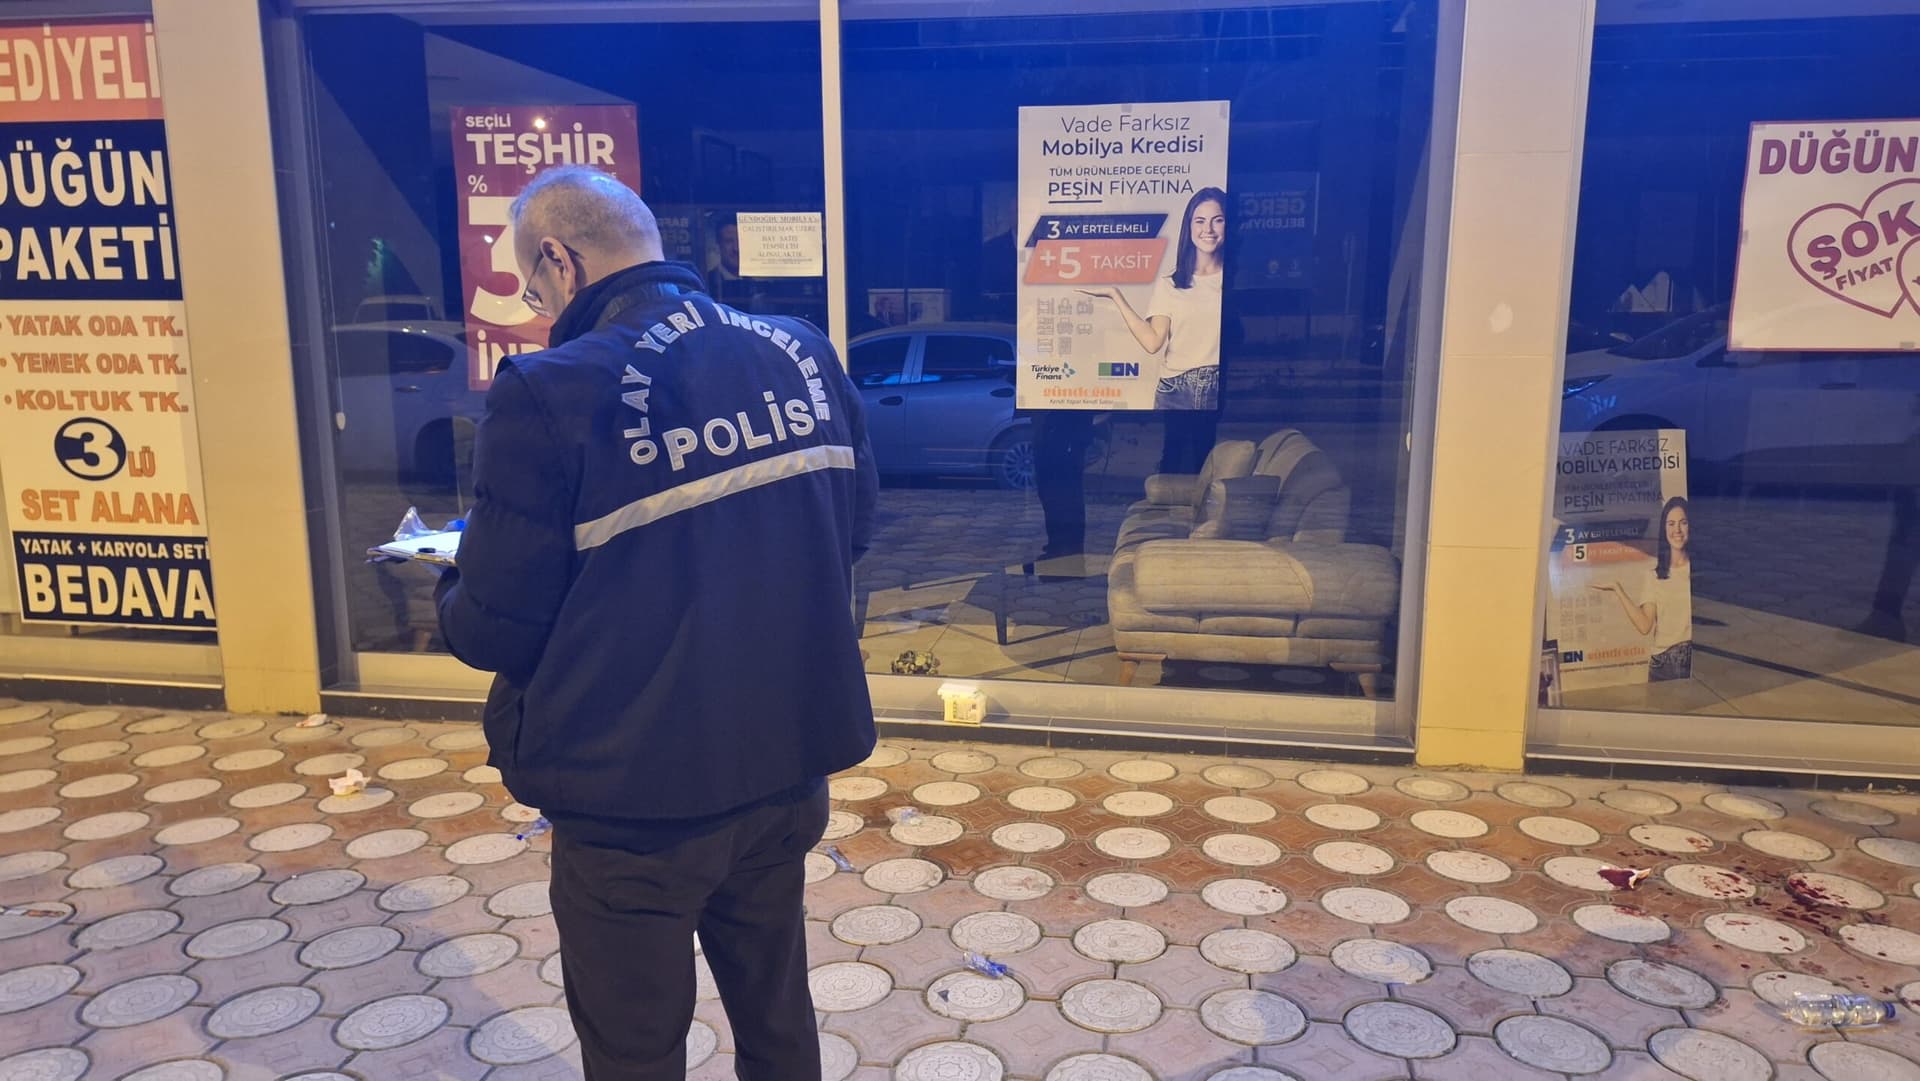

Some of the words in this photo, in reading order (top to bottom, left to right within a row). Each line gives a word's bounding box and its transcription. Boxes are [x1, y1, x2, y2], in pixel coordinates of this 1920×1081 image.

[465, 113, 512, 130] SEÇİLİ
[1061, 115, 1112, 133] Vade
[1119, 113, 1190, 132] Farksız
[466, 122, 615, 174] TEŞHİR
[1043, 137, 1123, 159] Mobilya
[1131, 134, 1204, 153] Kredisi
[1759, 129, 1919, 174] DÜĞÜN
[0, 138, 167, 207] ÜĞÜN
[1049, 165, 1073, 177] TÜM
[1075, 165, 1142, 176] ÜRÜNLERDE
[1145, 163, 1191, 176] GEÇERLİ
[467, 175, 488, 193] %
[1048, 179, 1103, 200] PEŞİN
[1110, 177, 1194, 195] FİYATINA
[1047, 221, 1060, 239] 3
[1065, 225, 1080, 234] AY
[1082, 222, 1149, 234] ERTELEMELİ
[1807, 200, 1920, 280] ŞOK
[1091, 252, 1152, 269] TAKSİT
[6, 315, 83, 336] YATAK
[88, 315, 138, 337] ODA
[142, 316, 183, 337] TK.
[11, 353, 91, 374] YEMEK
[96, 353, 144, 375] ODA
[148, 354, 187, 375] TK.
[477, 329, 545, 381] İN
[15, 389, 133, 412] KOLTUK
[139, 391, 189, 413] TK.
[621, 364, 658, 465] OLAY
[662, 390, 815, 472] POLİS
[1562, 441, 1605, 456] VADE
[1609, 438, 1669, 454] FARKSIZ
[1622, 452, 1681, 472] KREDİSİ
[21, 488, 80, 521] SET
[91, 490, 200, 525] ALANA
[1564, 491, 1605, 511] PEŞİN
[1565, 528, 1575, 543] 3
[20, 538, 73, 555] YATAK
[91, 540, 169, 559] KARYOLA
[1575, 546, 1585, 559] 5
[23, 563, 216, 620] BEDAVA
